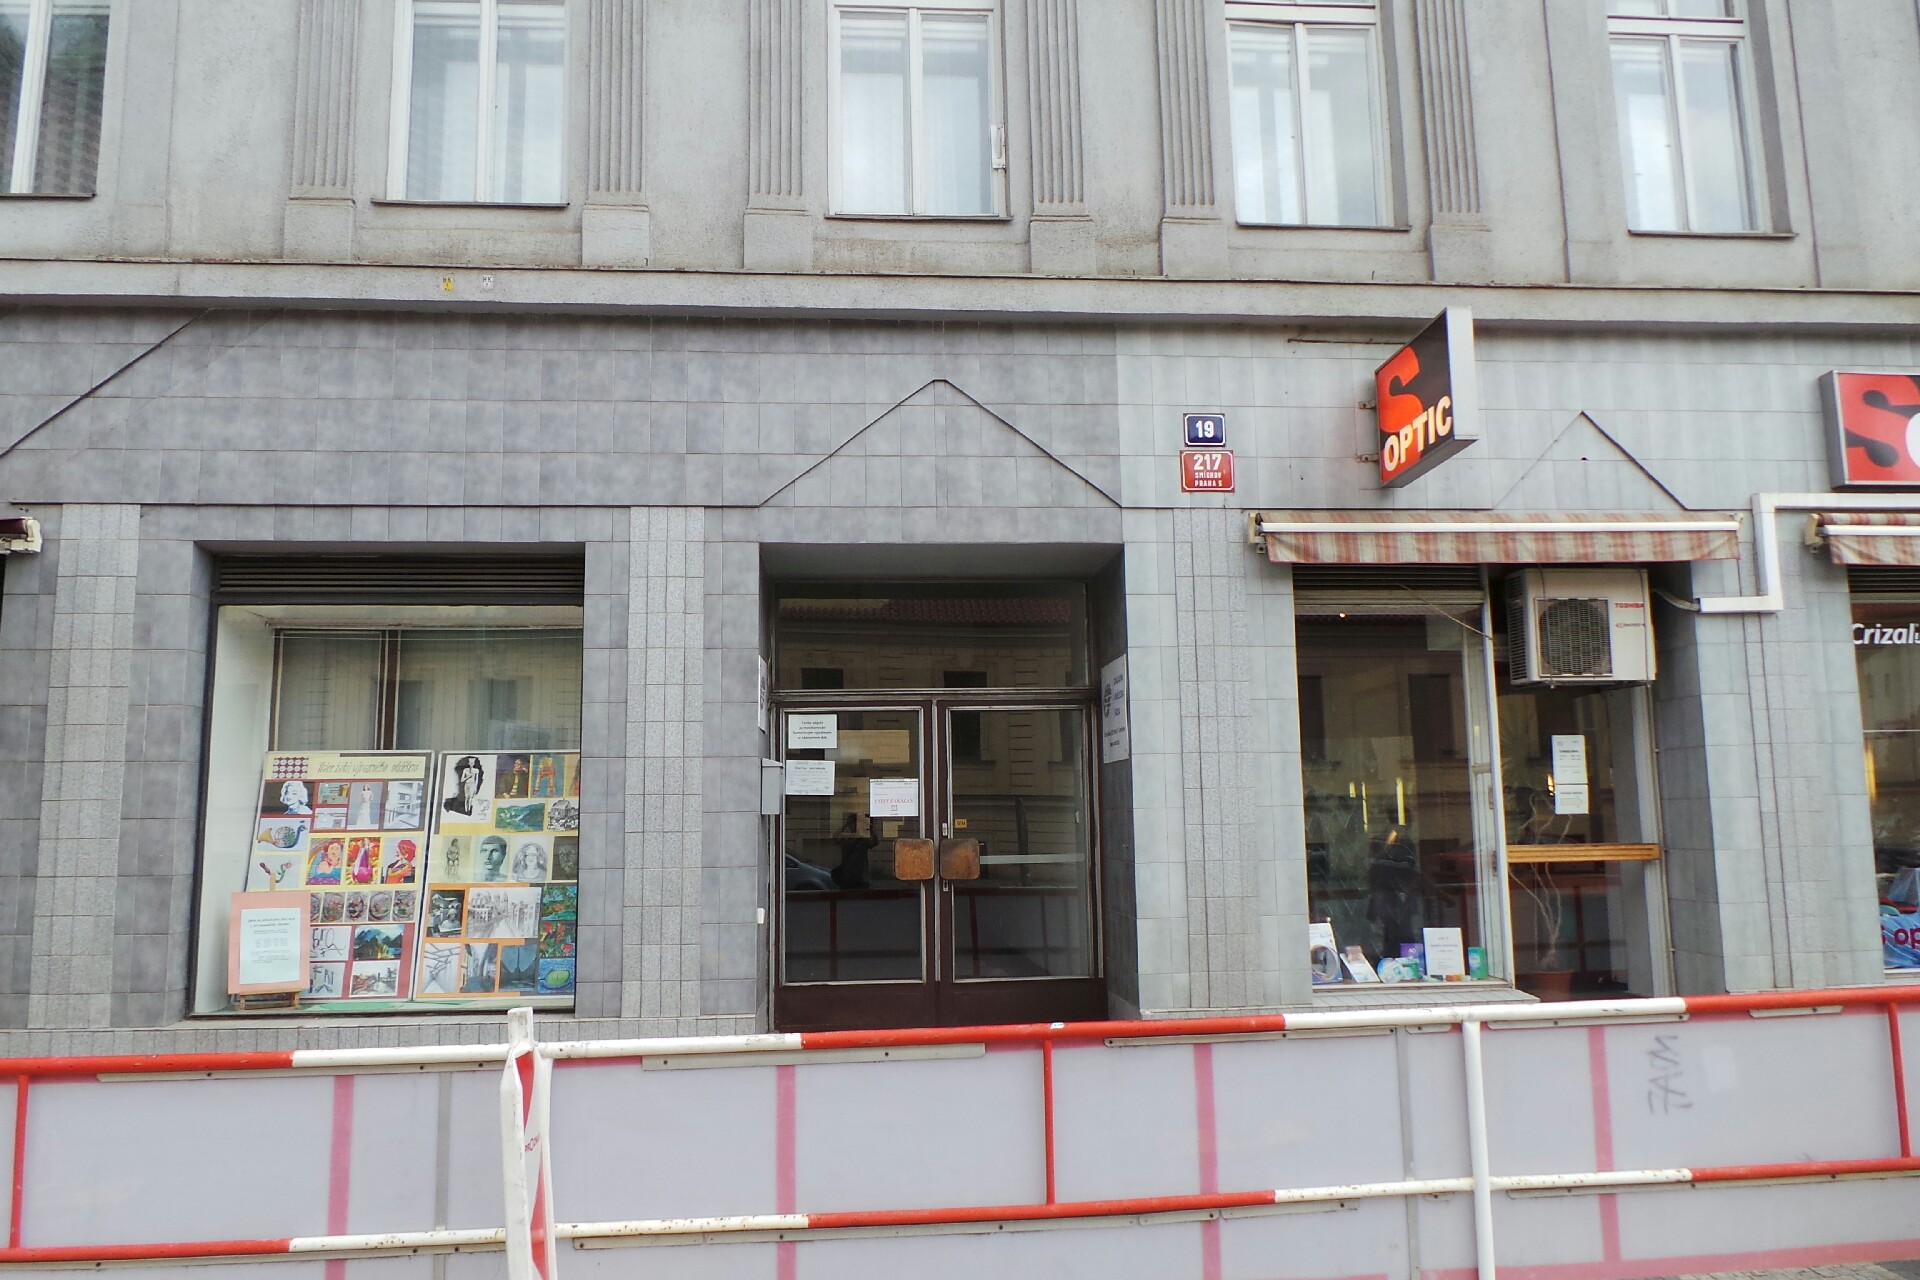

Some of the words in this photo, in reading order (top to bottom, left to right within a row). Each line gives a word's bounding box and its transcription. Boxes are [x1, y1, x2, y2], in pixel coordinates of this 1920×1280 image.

[1195, 420, 1215, 439] 19
[1384, 395, 1453, 472] OPTIC
[1193, 453, 1222, 471] 217
[1194, 479, 1217, 487] PRAHA
